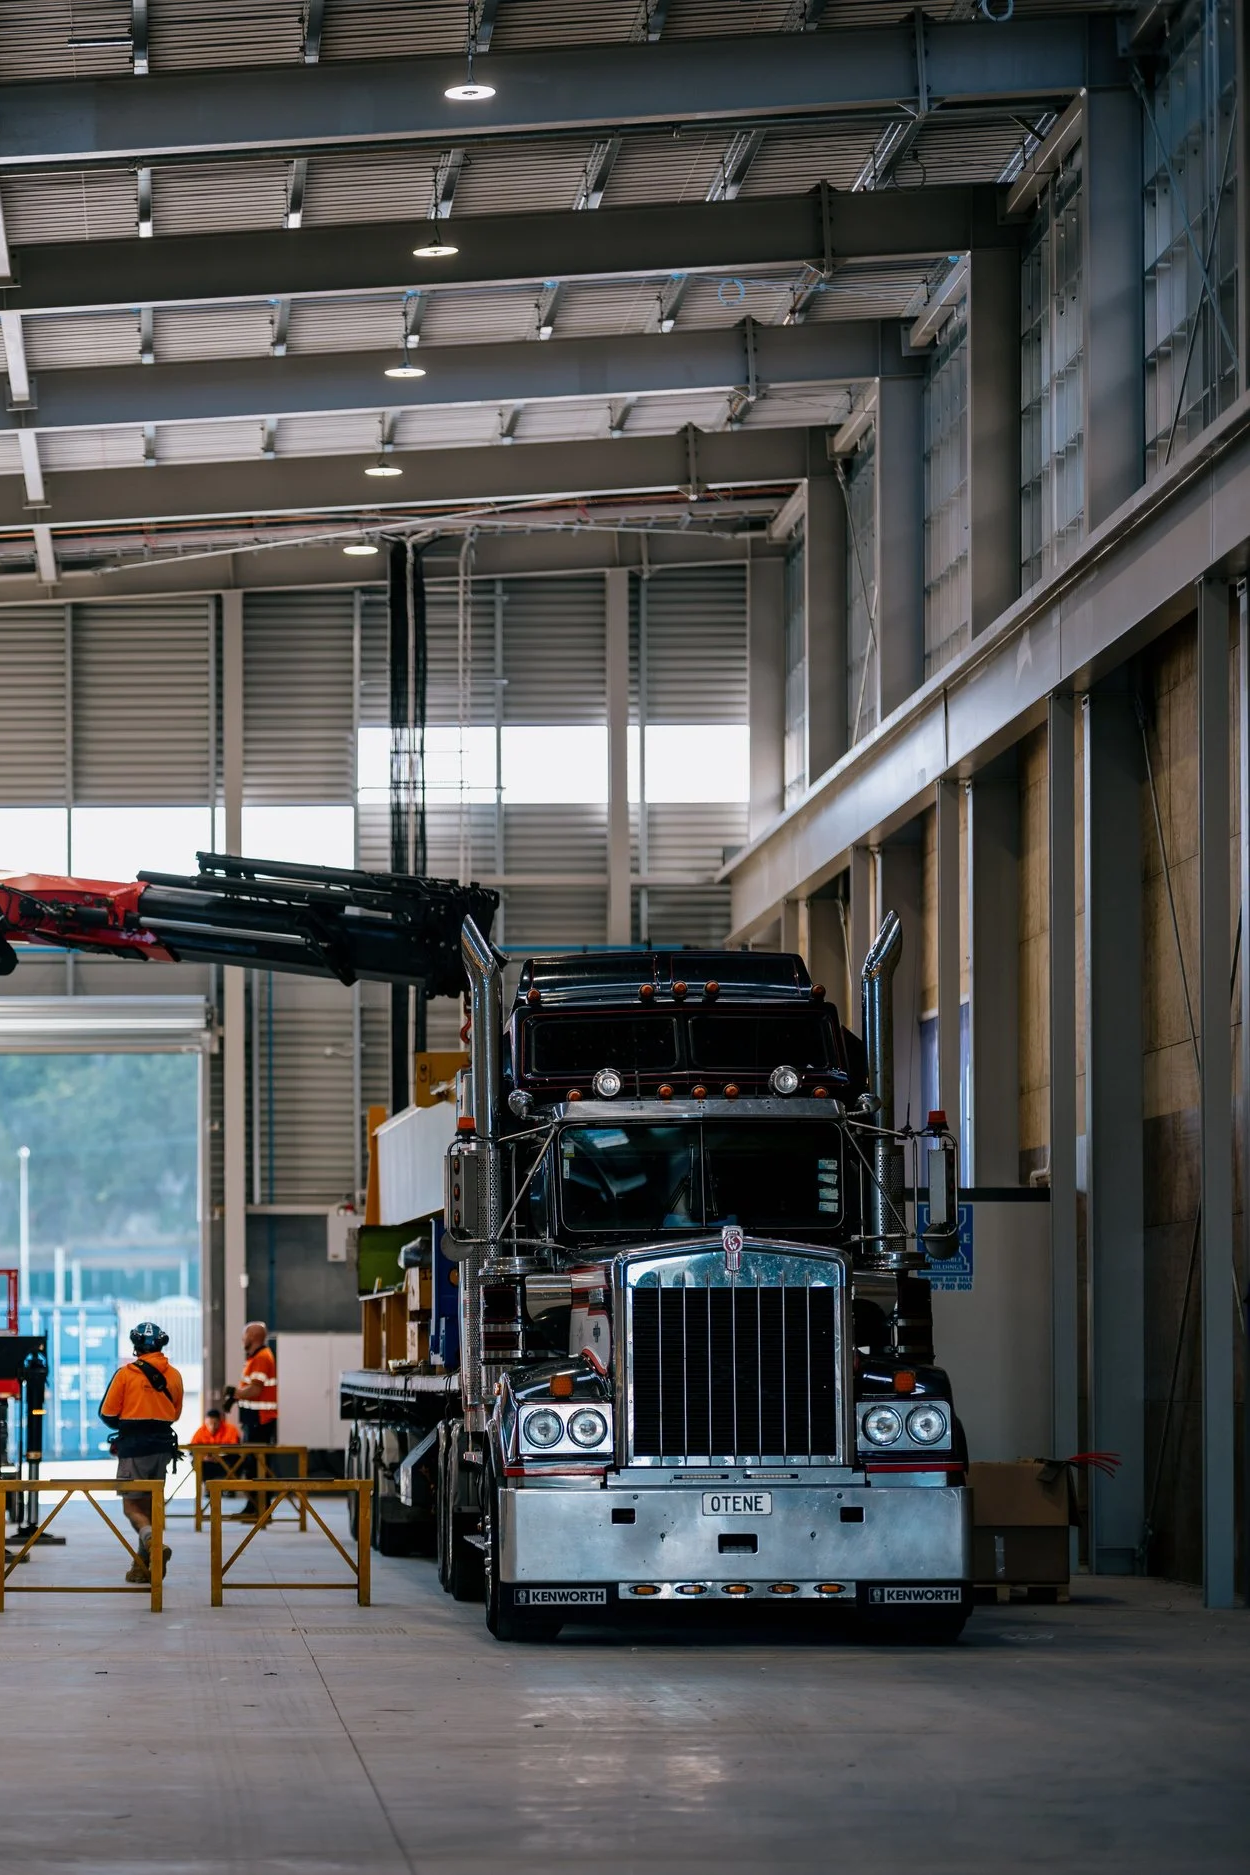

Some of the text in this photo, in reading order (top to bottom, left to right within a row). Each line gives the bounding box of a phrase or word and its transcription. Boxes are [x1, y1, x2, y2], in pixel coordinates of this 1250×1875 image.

[711, 1496, 764, 1512] OTENE
[532, 1591, 604, 1602] KENWORTH
[887, 1590, 959, 1601] KENWORTH
